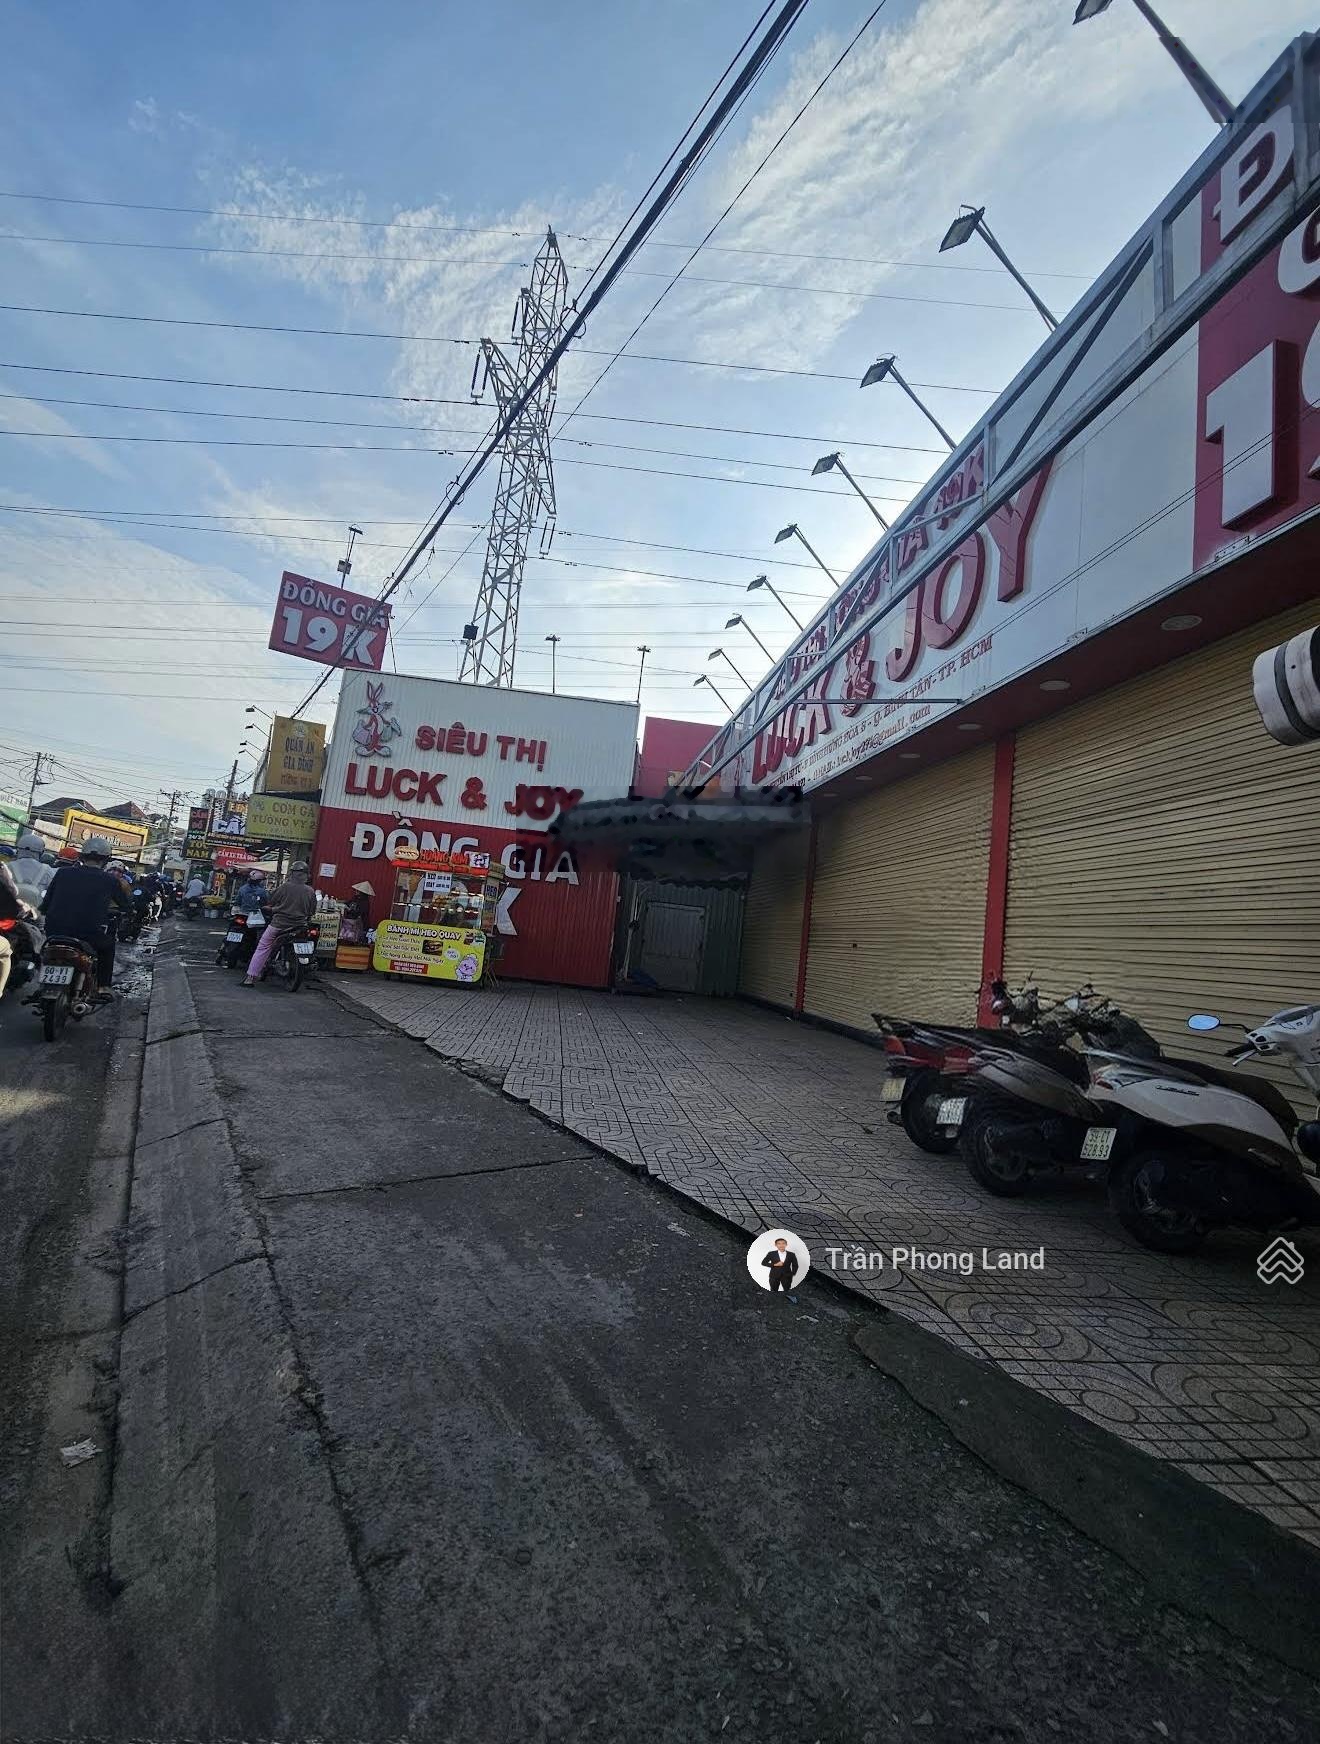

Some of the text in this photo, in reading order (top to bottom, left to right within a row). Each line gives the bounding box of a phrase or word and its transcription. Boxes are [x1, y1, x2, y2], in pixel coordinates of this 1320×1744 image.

[282, 578, 347, 616] ĐỒNG
[282, 606, 378, 666] 19K
[959, 633, 994, 669] HCM
[415, 721, 548, 772] SIÊU THỊ
[344, 762, 448, 806] LUCK
[460, 776, 488, 810] &
[420, 929, 438, 938] HEO
[439, 930, 461, 941] QUAY
